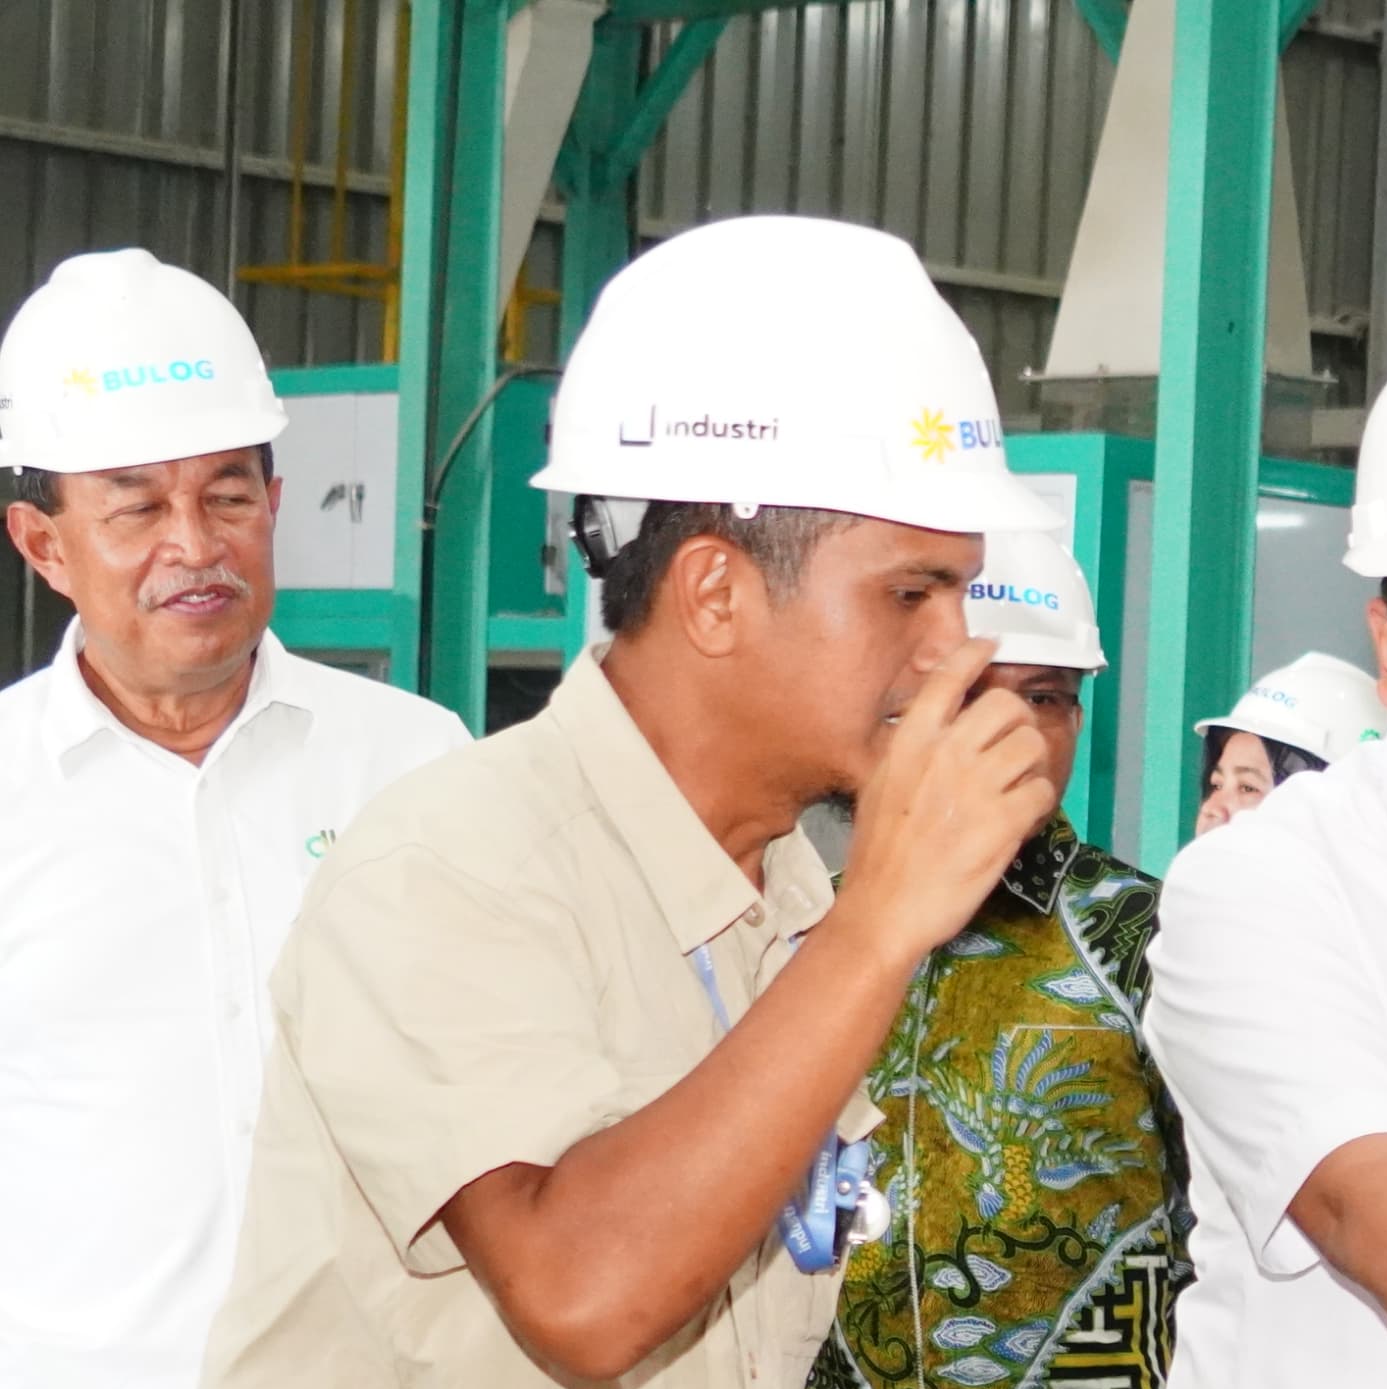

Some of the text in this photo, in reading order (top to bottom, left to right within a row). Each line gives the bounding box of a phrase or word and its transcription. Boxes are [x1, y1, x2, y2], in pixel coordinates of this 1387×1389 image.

[102, 359, 215, 393] BULOG
[665, 413, 779, 441] industri
[968, 582, 1060, 611] BULOG
